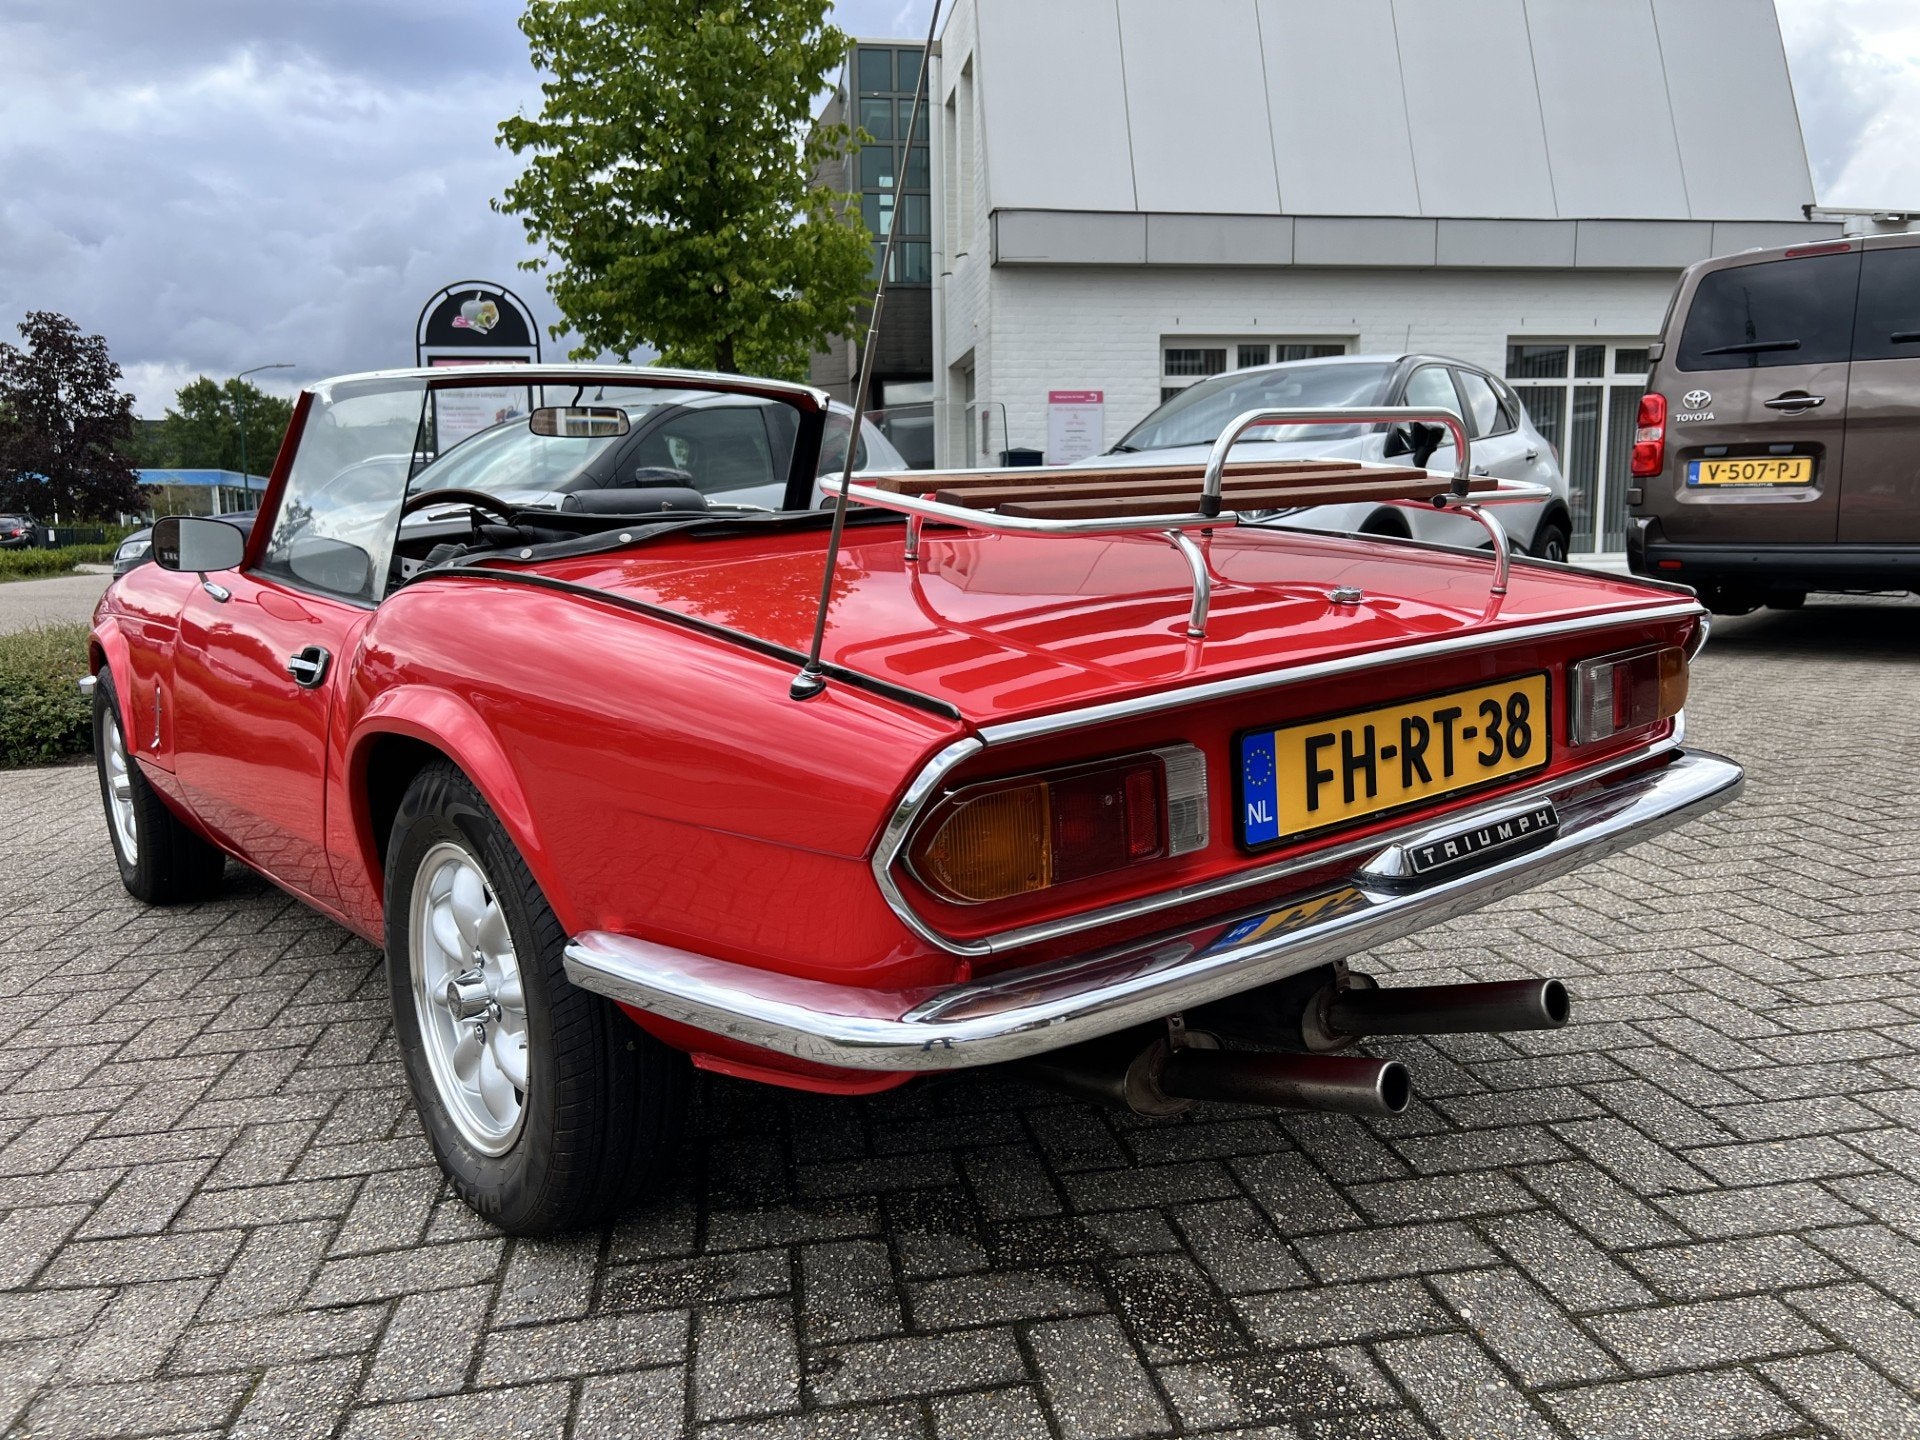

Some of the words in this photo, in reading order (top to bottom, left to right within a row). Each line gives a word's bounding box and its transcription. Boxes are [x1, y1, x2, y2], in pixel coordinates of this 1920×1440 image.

[1675, 412, 1715, 422] TOYOTA
[1708, 462, 1801, 480] V-507-PJ
[1304, 691, 1532, 812] FH-RT-38
[1247, 799, 1273, 826] NL
[1422, 810, 1550, 864] TRIUMPH
